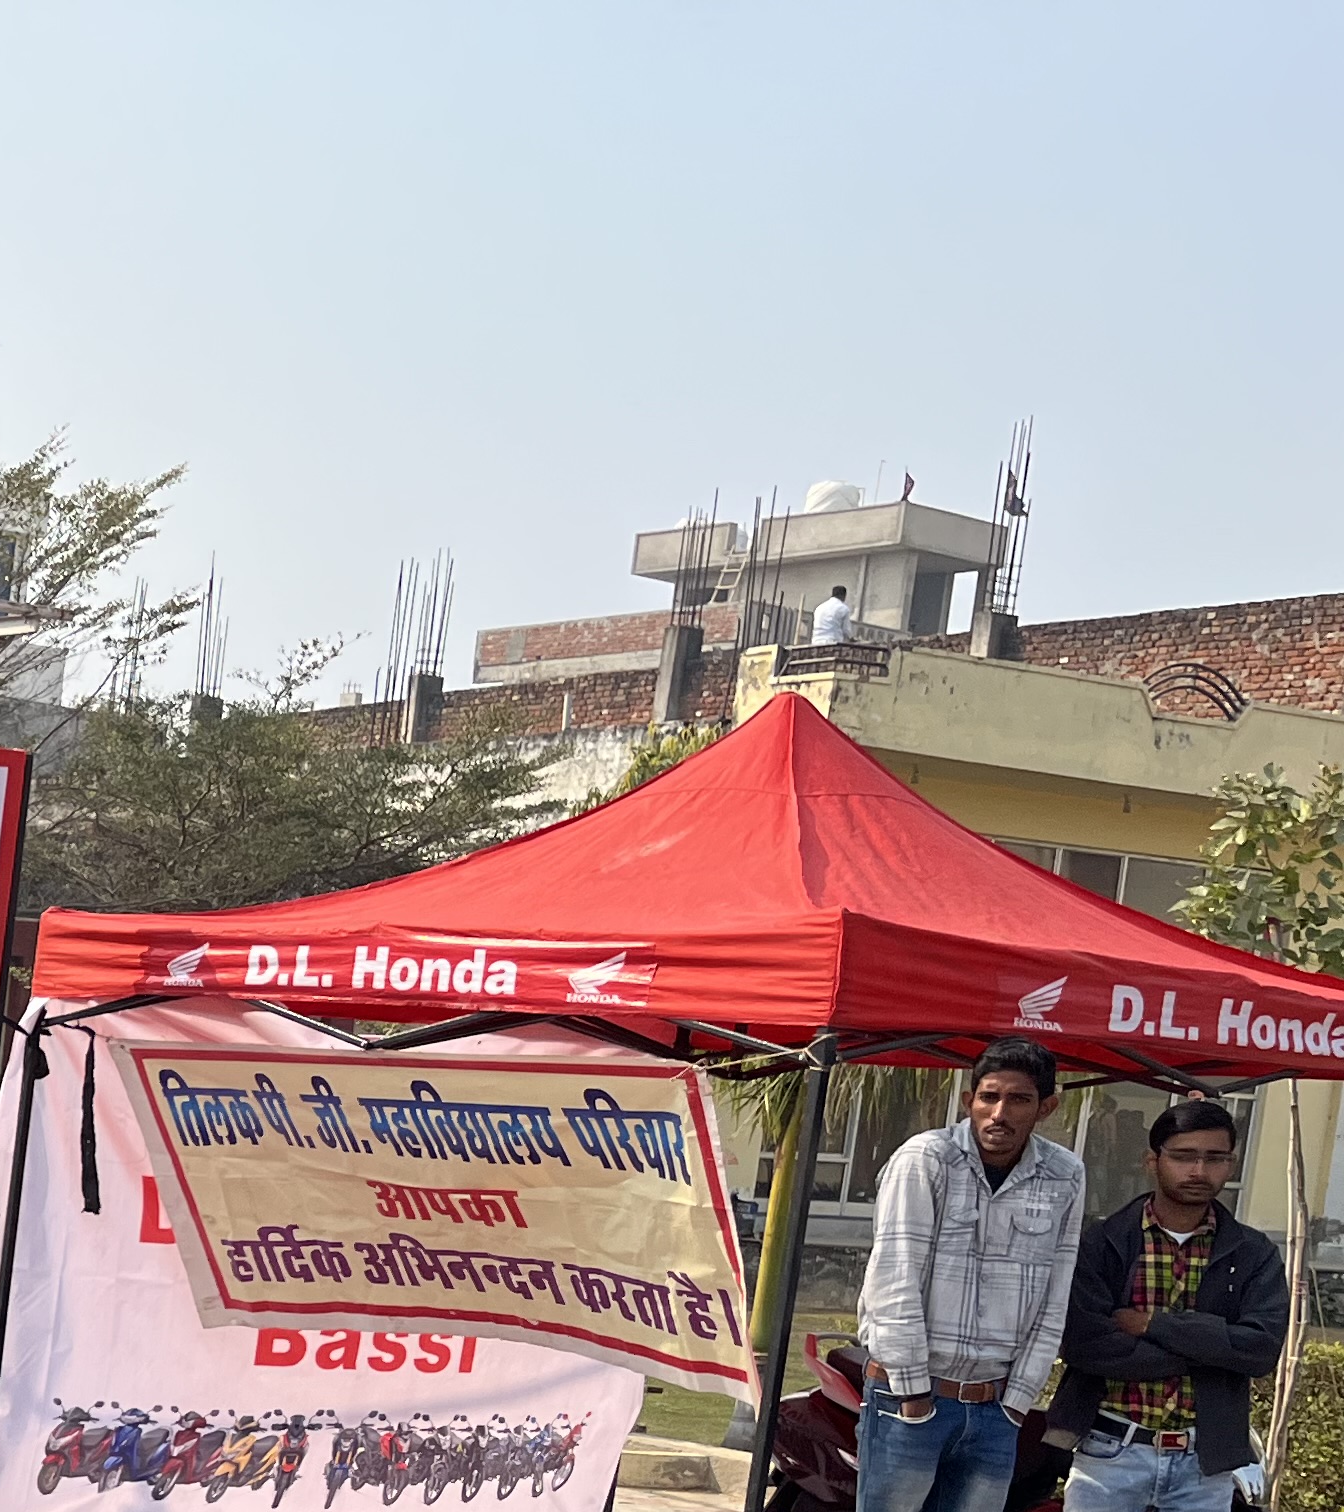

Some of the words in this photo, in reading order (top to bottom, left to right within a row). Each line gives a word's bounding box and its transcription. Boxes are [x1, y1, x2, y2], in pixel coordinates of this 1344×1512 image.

[243, 944, 333, 988] D.L.
[351, 945, 518, 995] Honda
[566, 992, 621, 1004] HONDA
[1108, 984, 1200, 1041] D.L.
[1013, 1017, 1063, 1032] HONDA
[159, 1069, 264, 1146] तिलक
[561, 1088, 692, 1186] परिवार
[365, 1179, 529, 1229] आपका
[220, 1223, 352, 1284] हार्दिक
[353, 1233, 566, 1306] अभिनन्दन
[561, 1263, 679, 1336] करता
